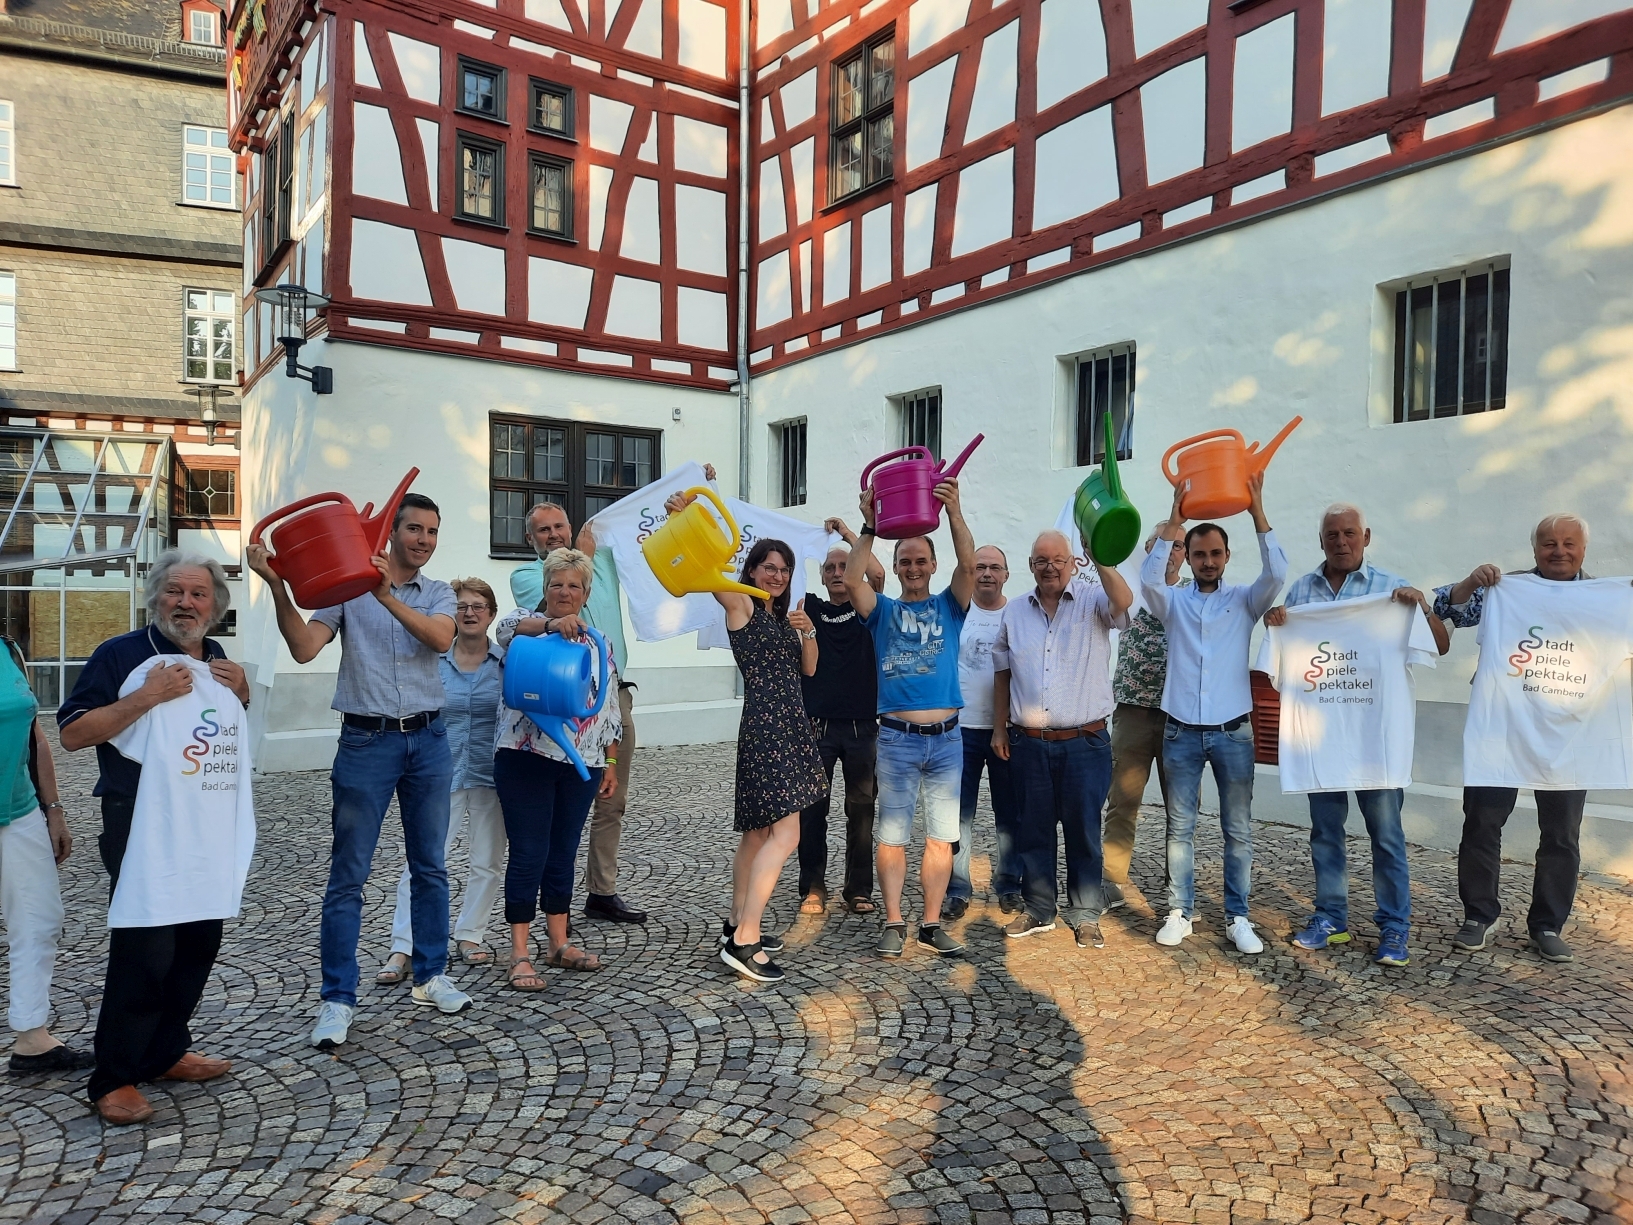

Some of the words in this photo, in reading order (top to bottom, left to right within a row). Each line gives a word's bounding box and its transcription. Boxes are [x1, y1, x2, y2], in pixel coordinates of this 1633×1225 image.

[901, 610, 943, 645] NYC
[1527, 625, 1575, 653] Stadt
[1317, 640, 1359, 664] Stadt
[1517, 639, 1571, 668] Spiele
[1310, 655, 1358, 679] Spiele
[1506, 653, 1587, 685] Spektakel
[1303, 670, 1374, 693] Spektakel
[1522, 683, 1540, 693] Bad
[1541, 684, 1585, 699] Camberg
[1319, 696, 1335, 704] Bad
[1336, 696, 1374, 706] Camberg
[192, 726, 238, 758] Spiele
[201, 781, 219, 791] Bad
